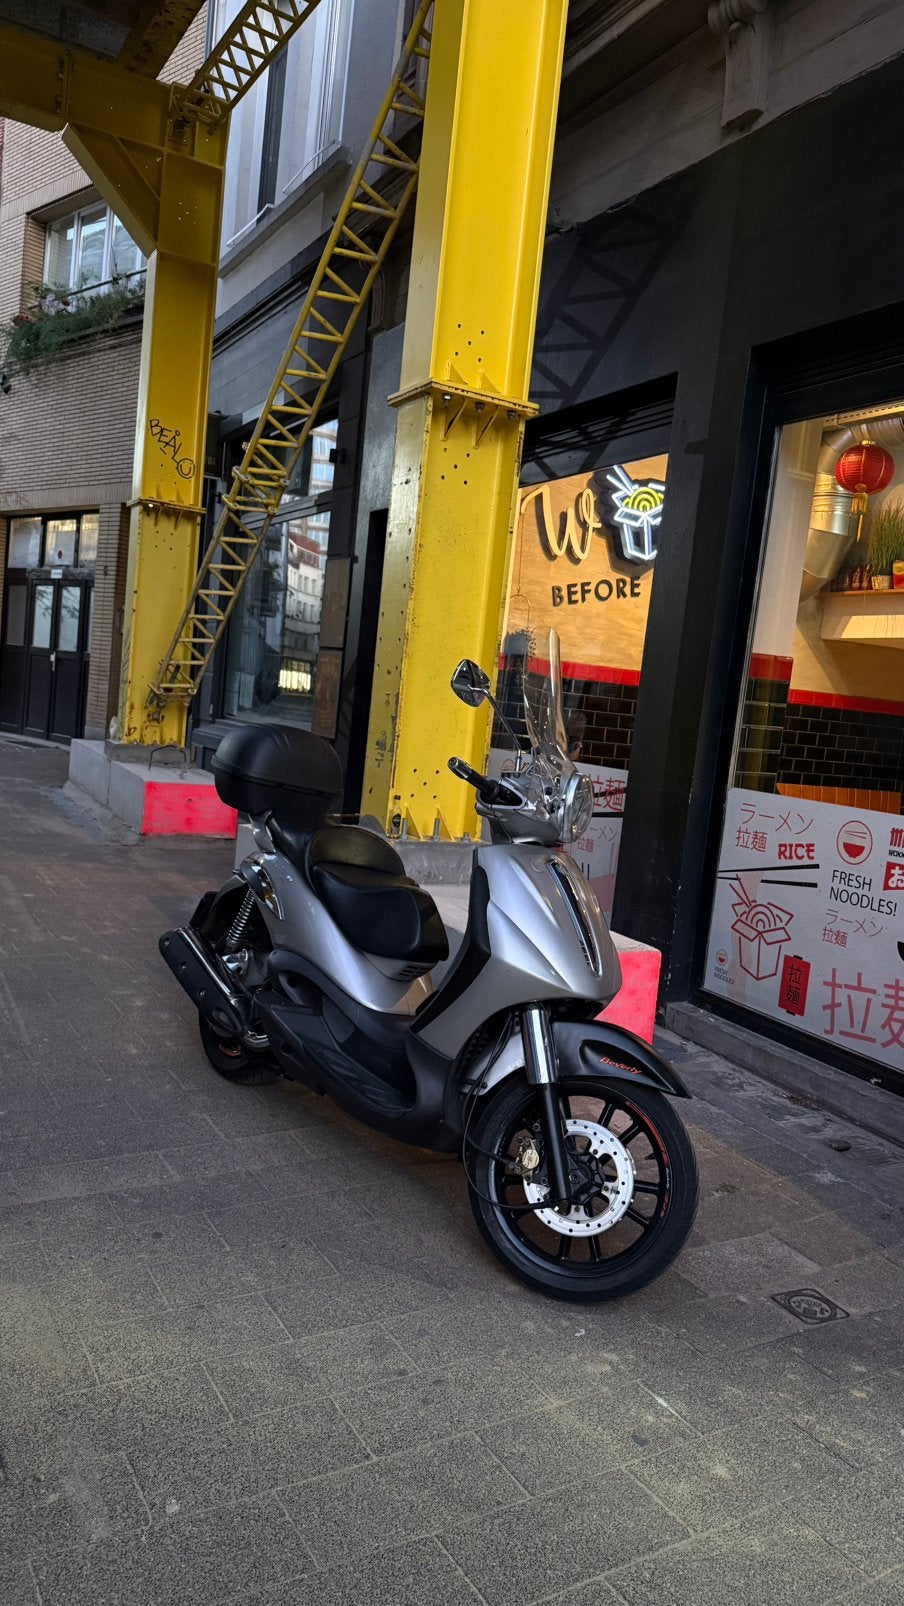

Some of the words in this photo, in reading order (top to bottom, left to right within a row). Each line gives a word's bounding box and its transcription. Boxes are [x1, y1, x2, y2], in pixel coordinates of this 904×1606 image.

[551, 577, 642, 607] BEFORE
[740, 802, 815, 836] ラーメン
[589, 824, 619, 842] ーメン
[777, 843, 816, 861] RICE
[831, 868, 873, 893] FRESH
[829, 886, 898, 917] NOODLES!
[825, 908, 884, 938] ラーメン
[600, 1056, 643, 1075] Beverly
